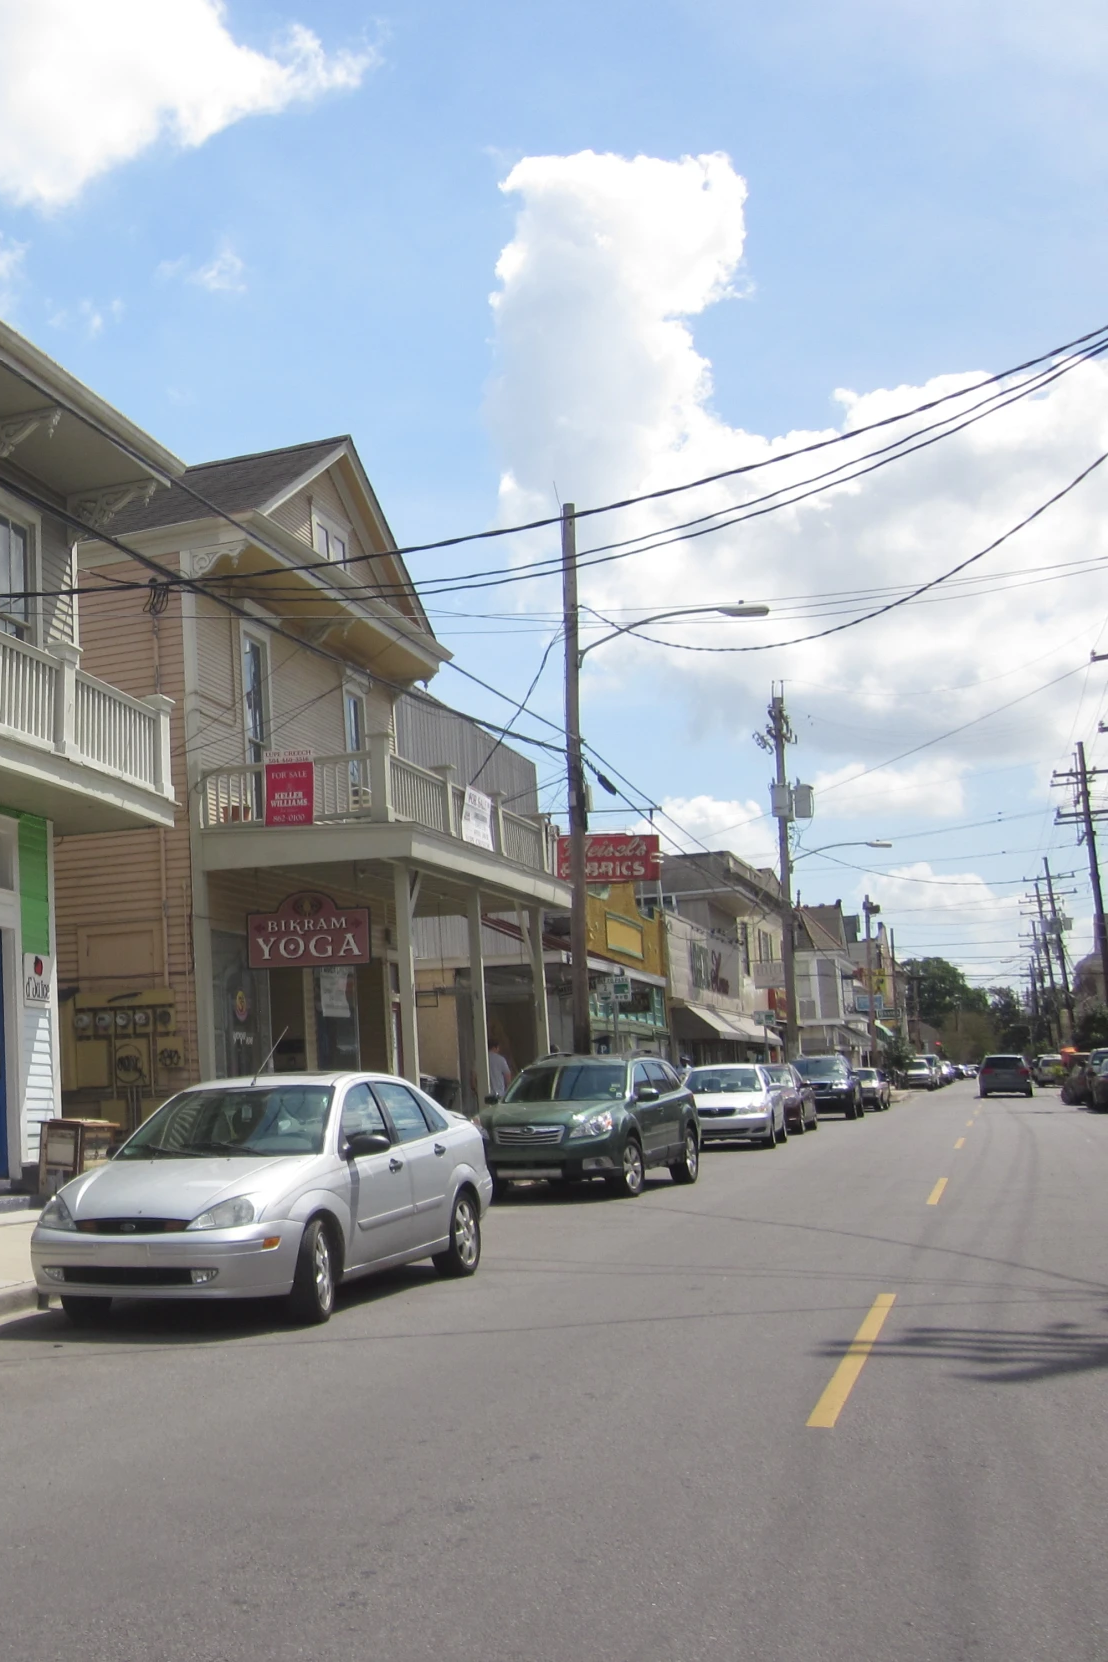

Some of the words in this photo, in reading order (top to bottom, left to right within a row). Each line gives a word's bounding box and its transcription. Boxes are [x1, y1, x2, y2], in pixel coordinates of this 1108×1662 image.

[272, 771, 287, 779] FOR
[289, 770, 308, 779] SALE
[274, 791, 303, 800] KELLER
[270, 799, 308, 808] WILLIAMS
[267, 917, 348, 934] BIKRAM
[256, 933, 362, 960] YOGA
